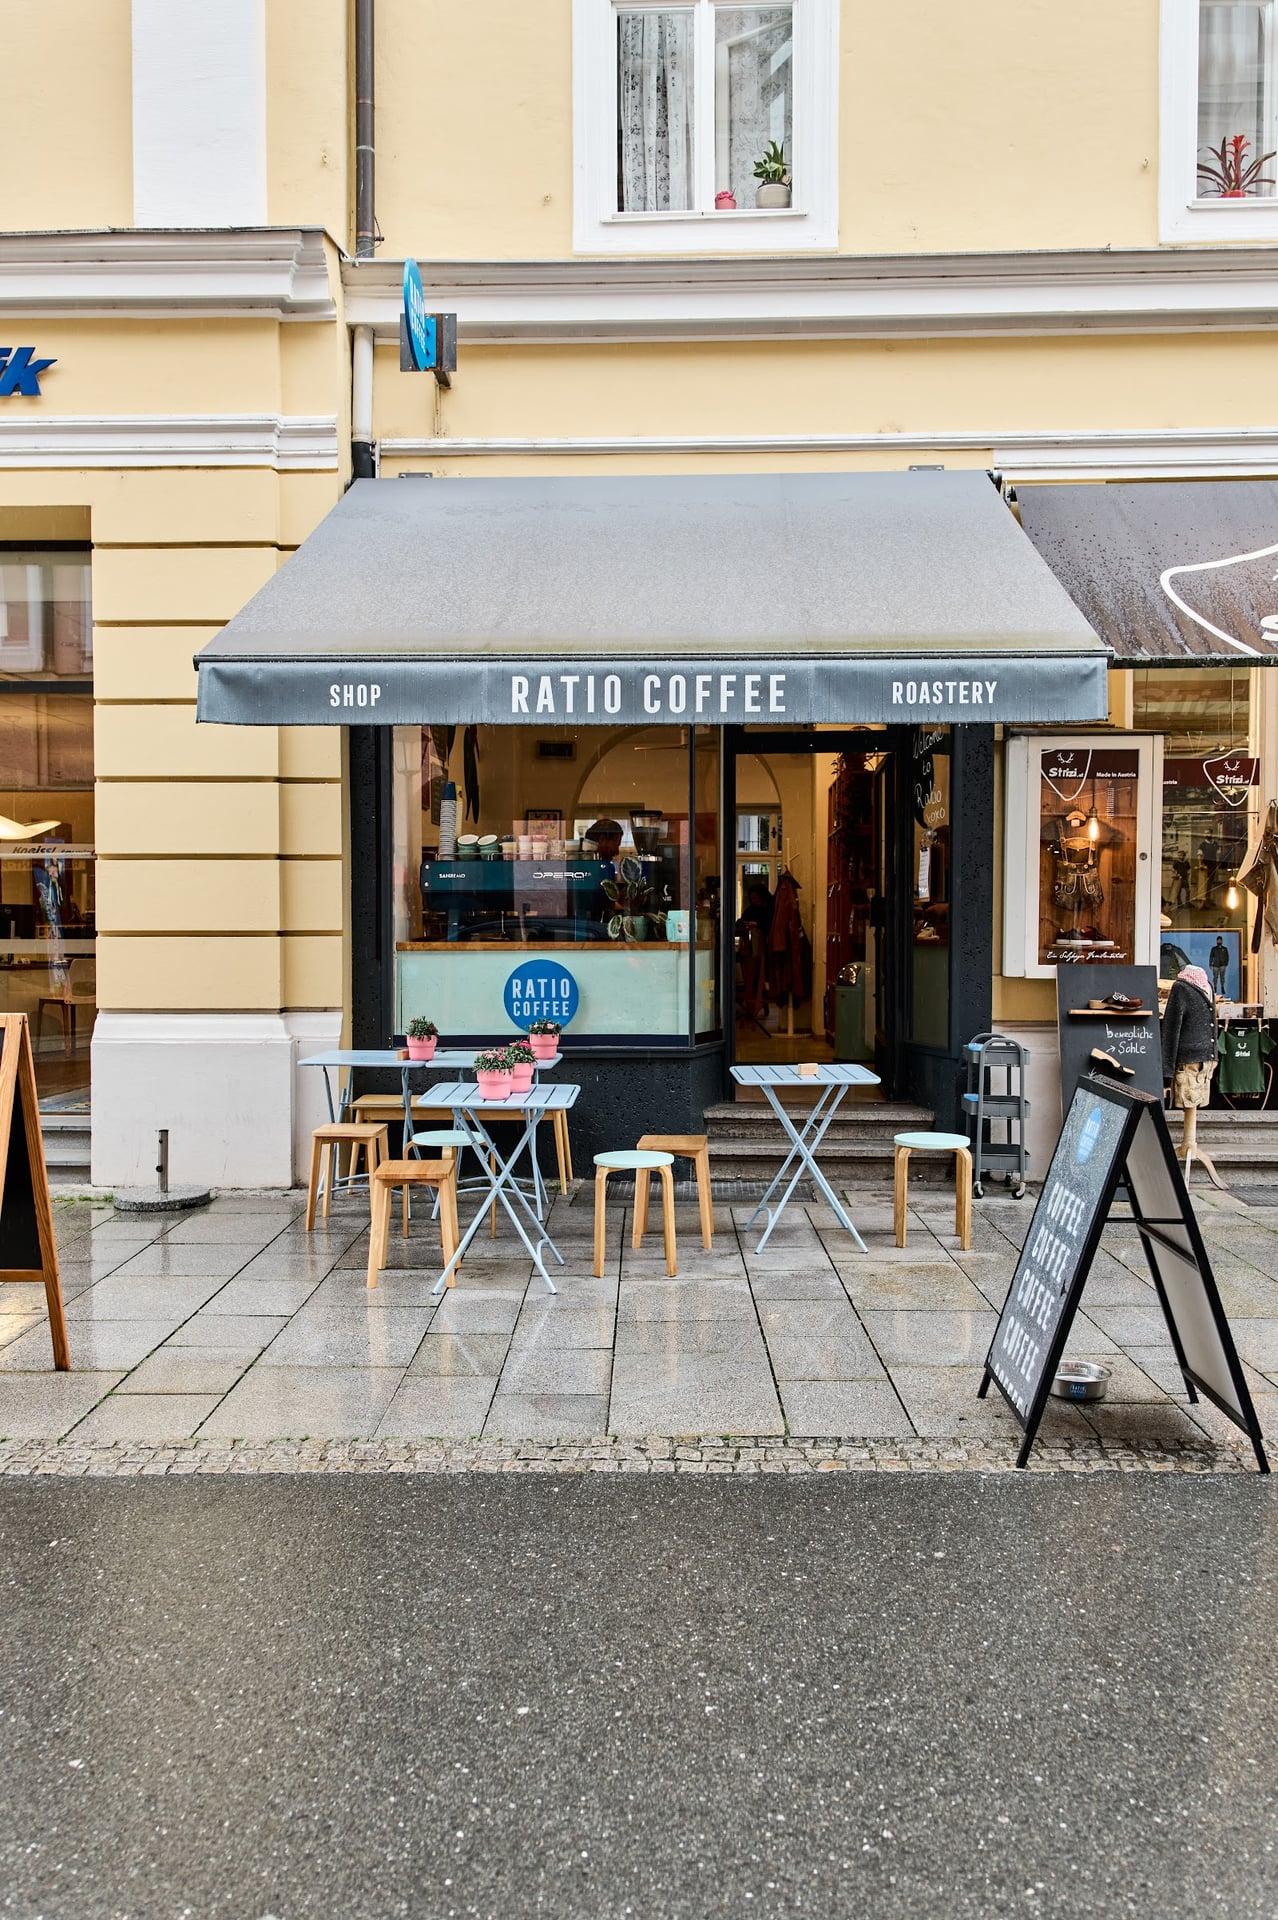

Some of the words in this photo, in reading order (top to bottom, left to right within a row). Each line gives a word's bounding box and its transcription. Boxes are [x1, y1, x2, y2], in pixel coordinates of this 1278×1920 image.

[329, 684, 381, 707] SHOP
[511, 675, 622, 713] RATIO
[644, 674, 786, 713] COFFEE
[892, 681, 998, 704] ROASTERY
[922, 760, 932, 776] to
[914, 779, 942, 809] Ratio
[512, 978, 570, 999] RATIO
[513, 1001, 570, 1017] COFFEE
[1105, 1023, 1153, 1040] bewegliche
[1047, 1182, 1085, 1237] COFFEE
[1032, 1225, 1070, 1283] COFFEE
[1017, 1268, 1055, 1331] COFFEE
[1002, 1315, 1040, 1382] COFFEE
